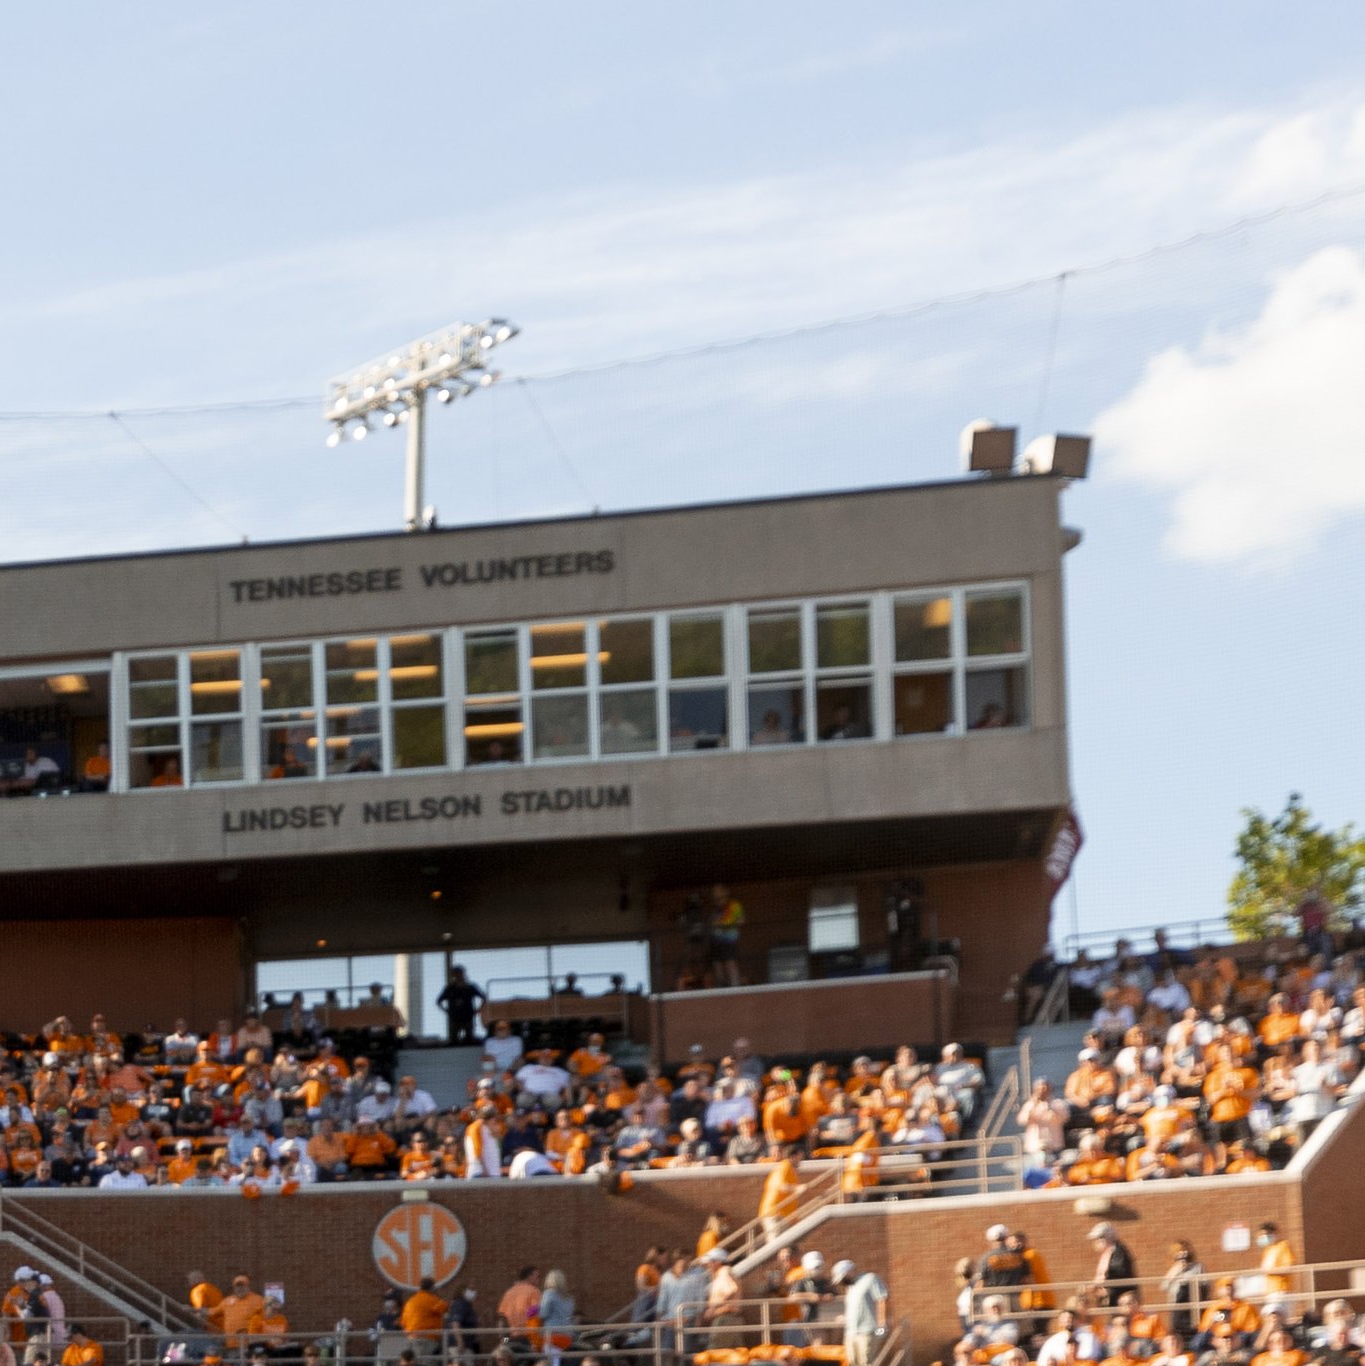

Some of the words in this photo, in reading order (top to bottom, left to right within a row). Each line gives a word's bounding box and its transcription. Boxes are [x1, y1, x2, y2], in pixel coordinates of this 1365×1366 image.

[231, 568, 402, 602] TENNESSEE
[420, 551, 615, 587] VOLUNTEERS
[223, 803, 344, 832] LINDSEY
[363, 794, 481, 823] NELSON
[501, 785, 631, 815] STADIUM
[377, 1203, 463, 1288] SEC
